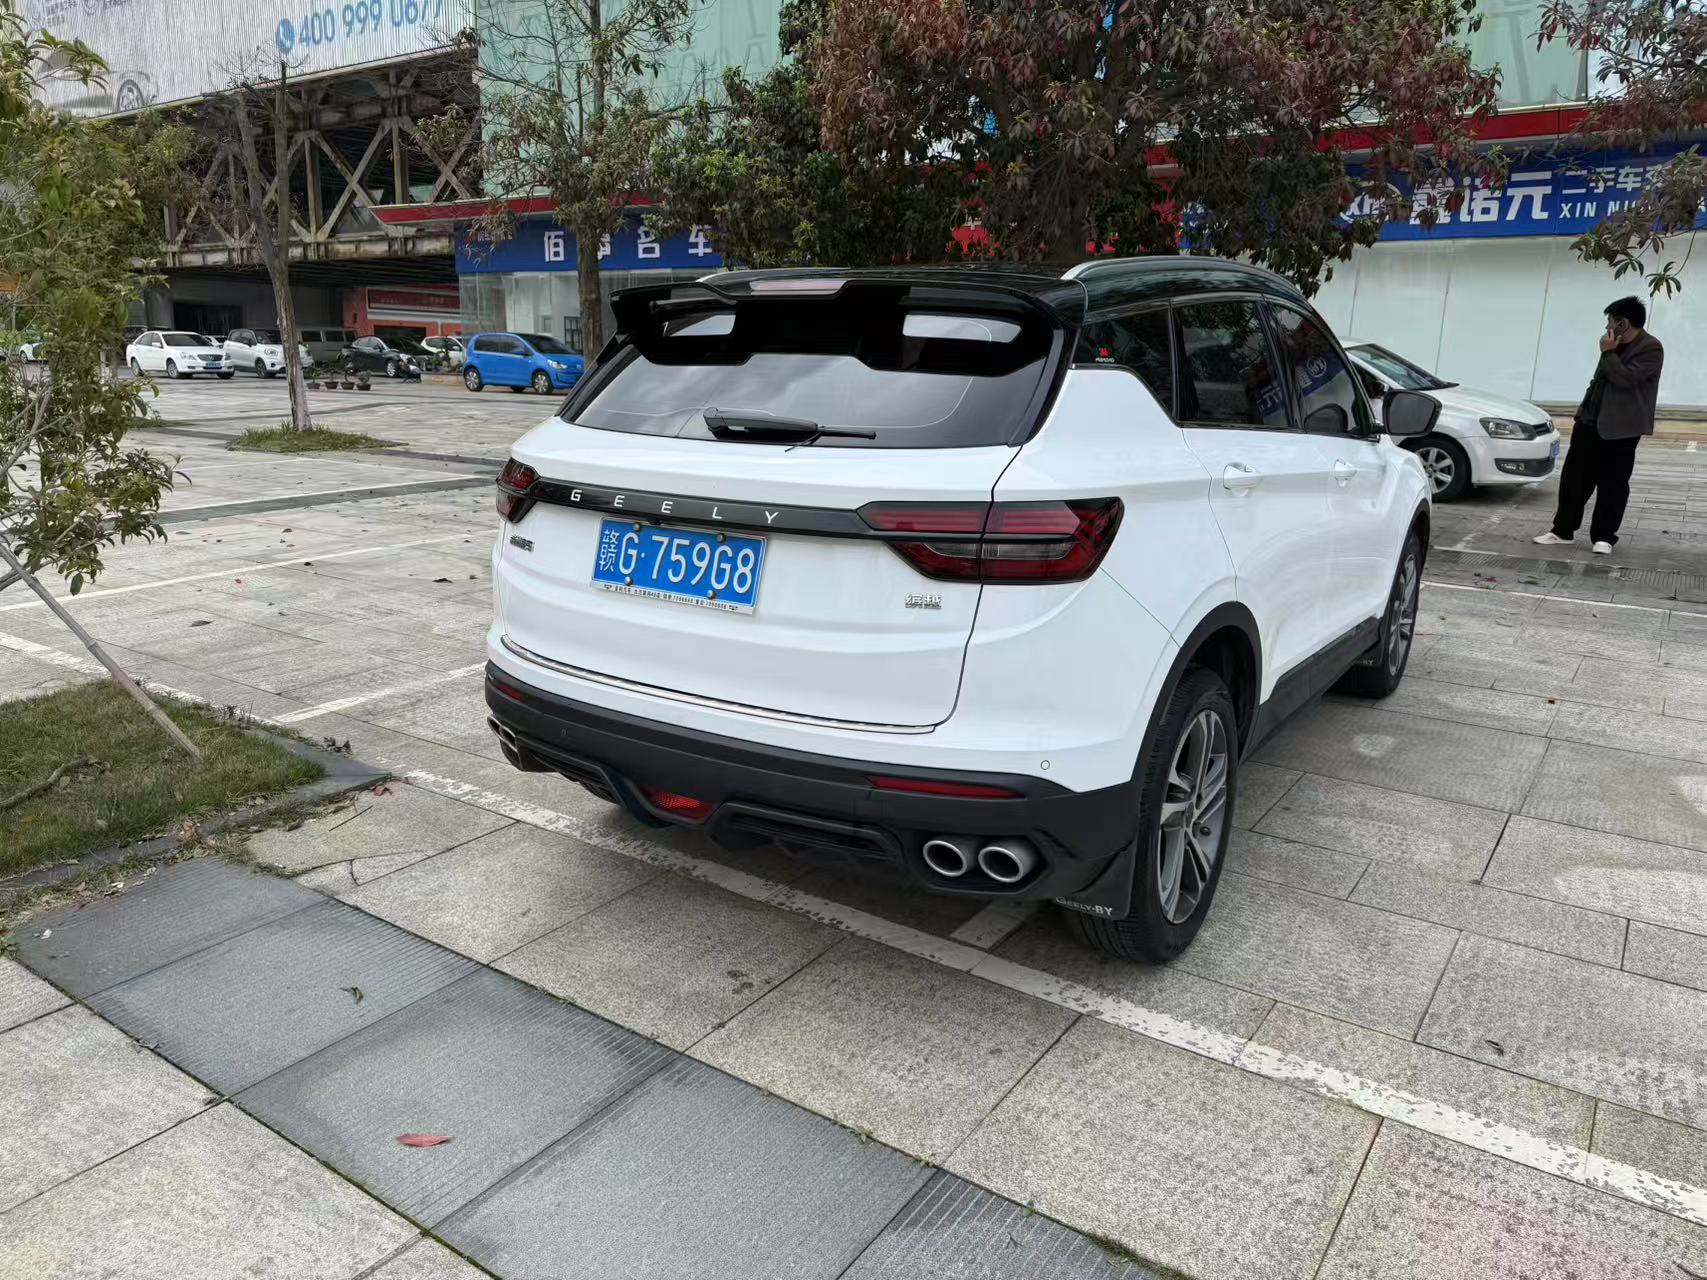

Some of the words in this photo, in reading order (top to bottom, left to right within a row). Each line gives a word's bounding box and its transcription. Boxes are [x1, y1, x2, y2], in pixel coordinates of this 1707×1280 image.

[299, 9, 336, 47] 400
[342, 0, 383, 37] 999
[1559, 201, 1597, 219] XIN
[570, 489, 779, 525] GEELY
